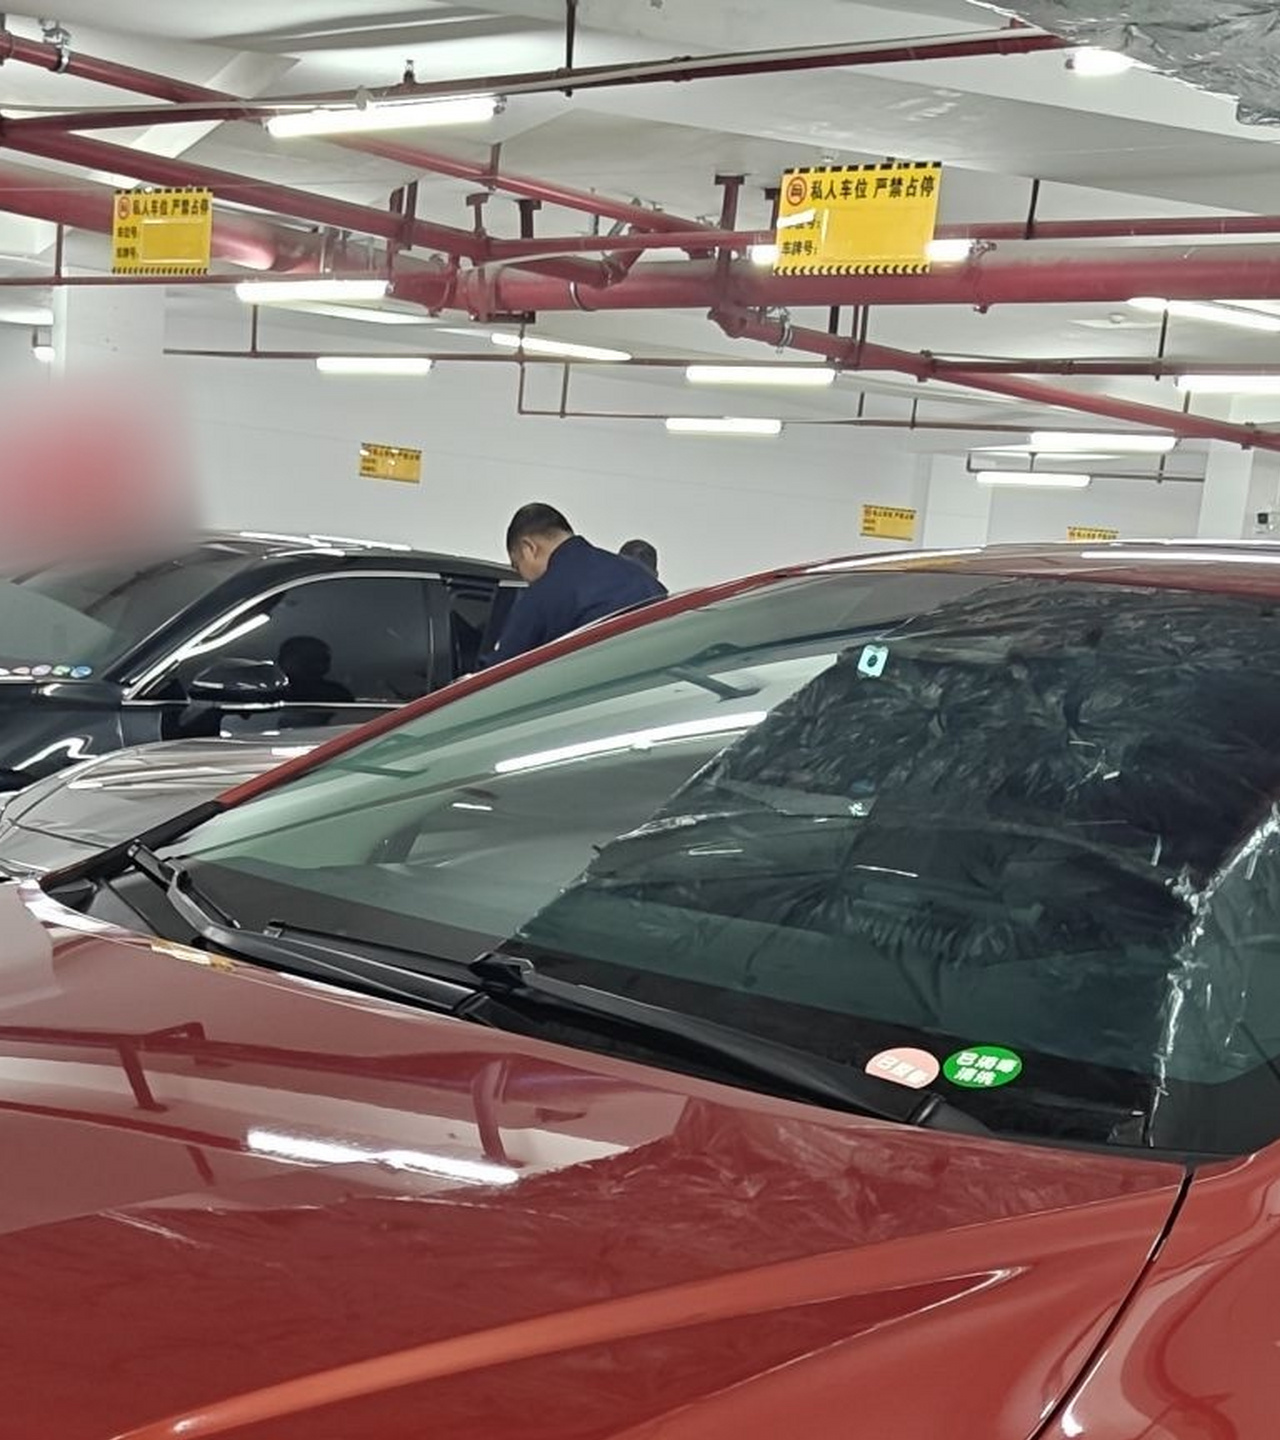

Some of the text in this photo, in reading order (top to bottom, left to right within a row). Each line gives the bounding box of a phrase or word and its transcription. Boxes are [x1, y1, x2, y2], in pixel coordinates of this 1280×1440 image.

[810, 175, 935, 200] 私人车位 严禁占停
